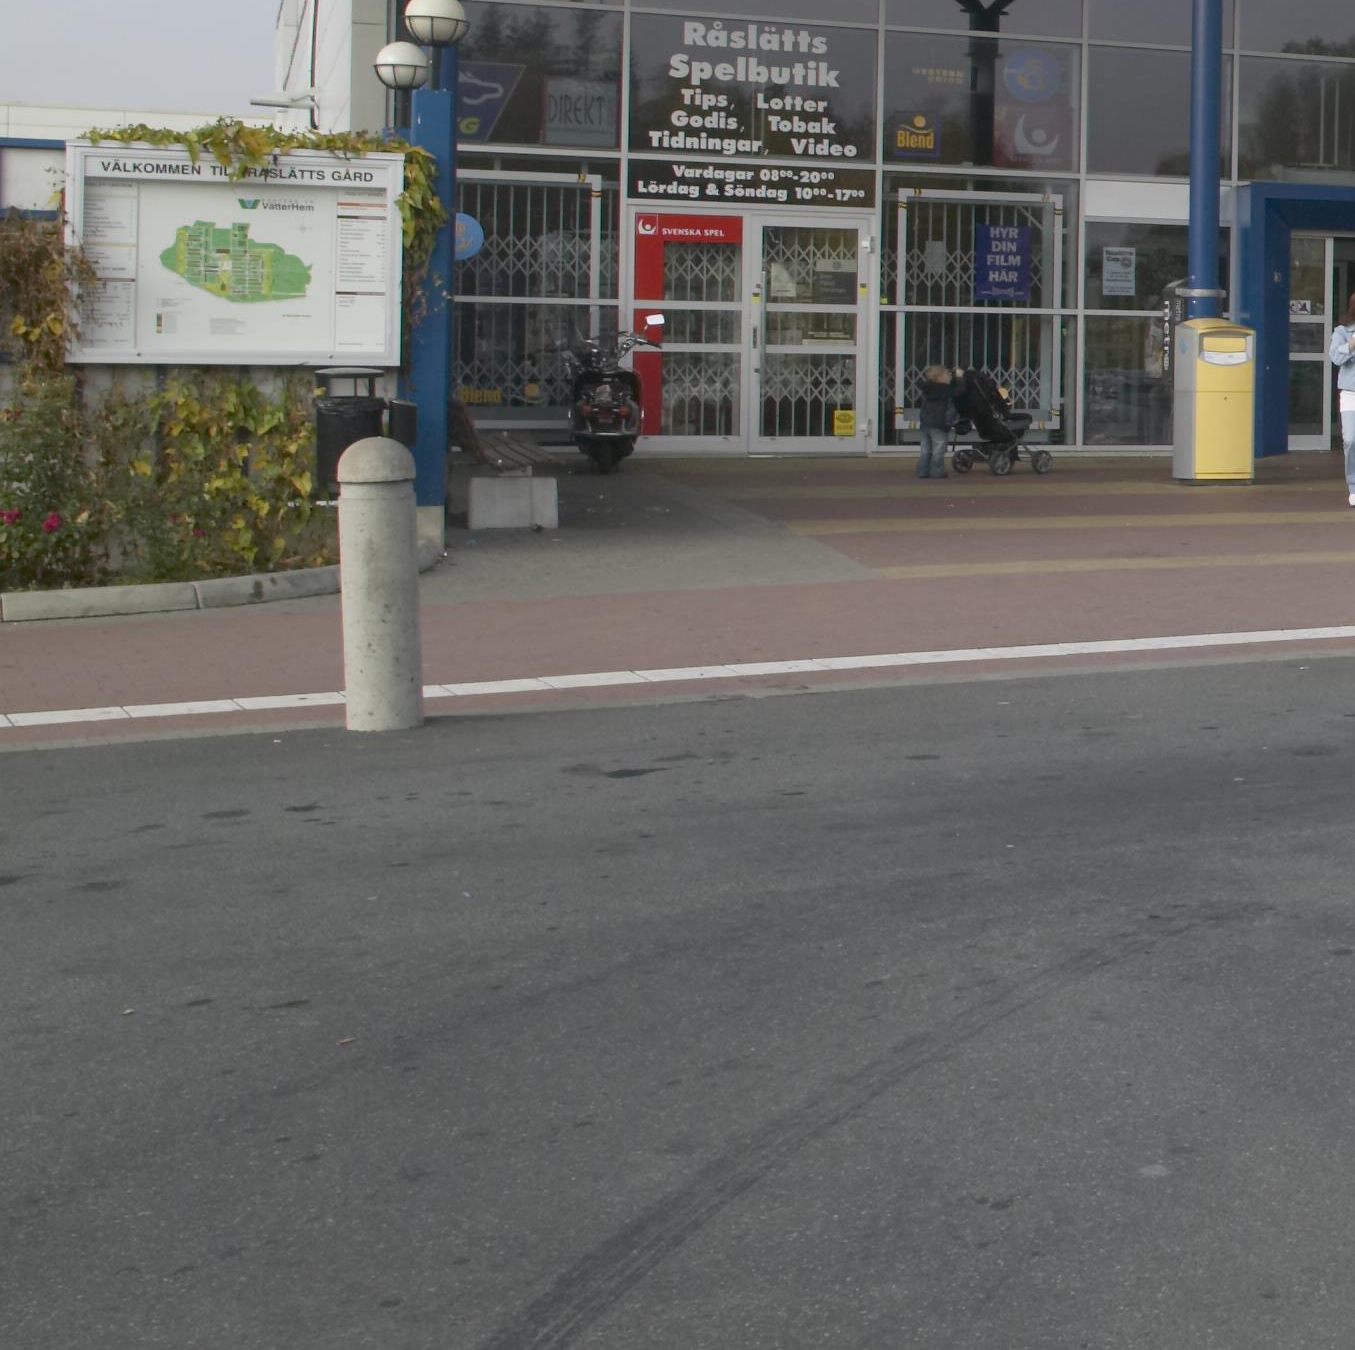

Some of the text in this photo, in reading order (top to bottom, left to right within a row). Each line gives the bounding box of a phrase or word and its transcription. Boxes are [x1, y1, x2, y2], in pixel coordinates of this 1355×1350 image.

[683, 21, 829, 54] Råslätts
[668, 54, 840, 88] Spelbutik
[681, 89, 828, 113] Tips, Lotter
[671, 111, 836, 135] Godis, Tobak
[648, 131, 858, 157] Tidningar, Video
[897, 130, 934, 149] Blend
[101, 159, 201, 176] VÄLKOMMEN
[210, 165, 237, 177] TIL
[331, 167, 374, 183] GÅRD
[672, 165, 754, 181] Vardagar
[637, 181, 699, 198] Lördag
[705, 184, 720, 197] &
[724, 184, 788, 201] Söndag
[662, 228, 725, 237] SVENSKA SPEL
[990, 227, 1019, 239] HYR
[992, 241, 1017, 252] DIN
[987, 255, 1021, 267] FILM
[988, 268, 1019, 282] HÄR
